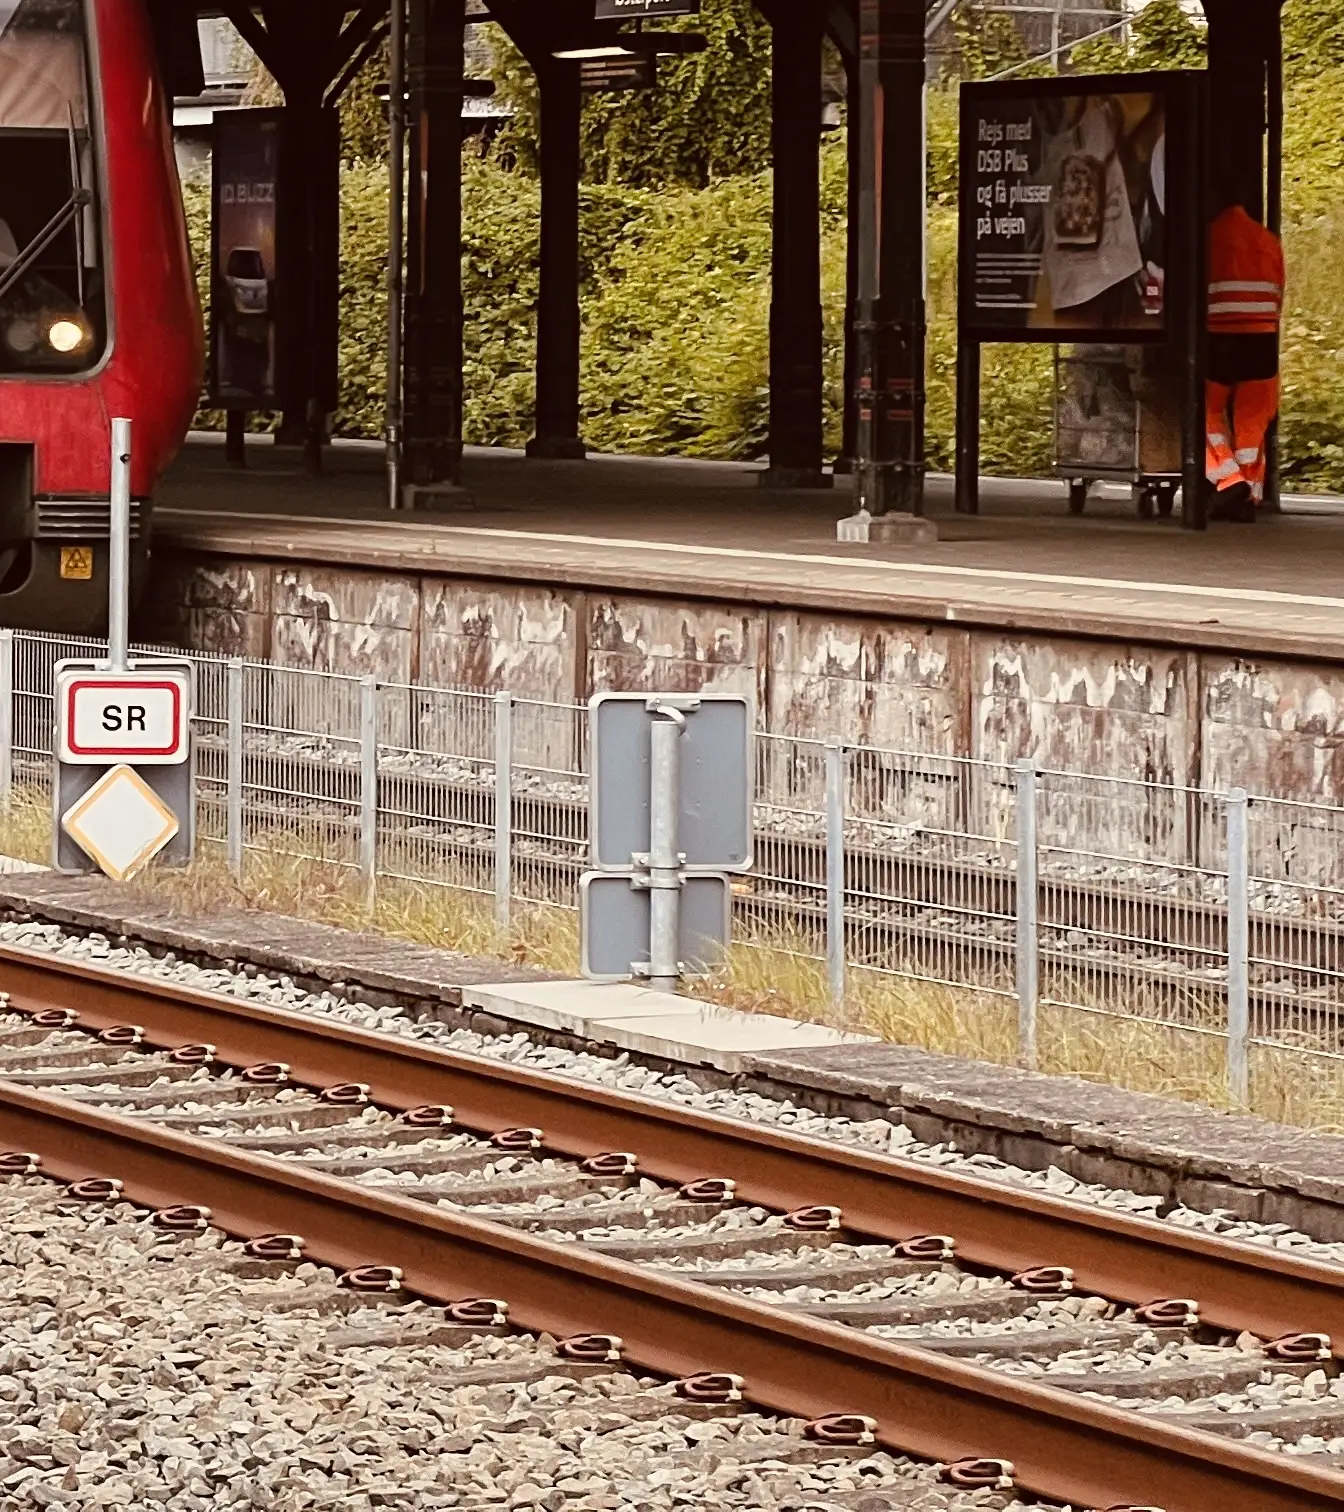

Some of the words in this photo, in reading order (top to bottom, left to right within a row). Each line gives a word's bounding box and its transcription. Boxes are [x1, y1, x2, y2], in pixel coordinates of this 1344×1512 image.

[978, 119, 1003, 146] Rejs
[977, 149, 1002, 172] DSB
[1004, 148, 1028, 172] Plus
[977, 184, 992, 208] og
[1010, 179, 1052, 208] plusser
[976, 210, 992, 240] på
[994, 211, 1025, 239] vejen
[102, 704, 146, 731] SR
